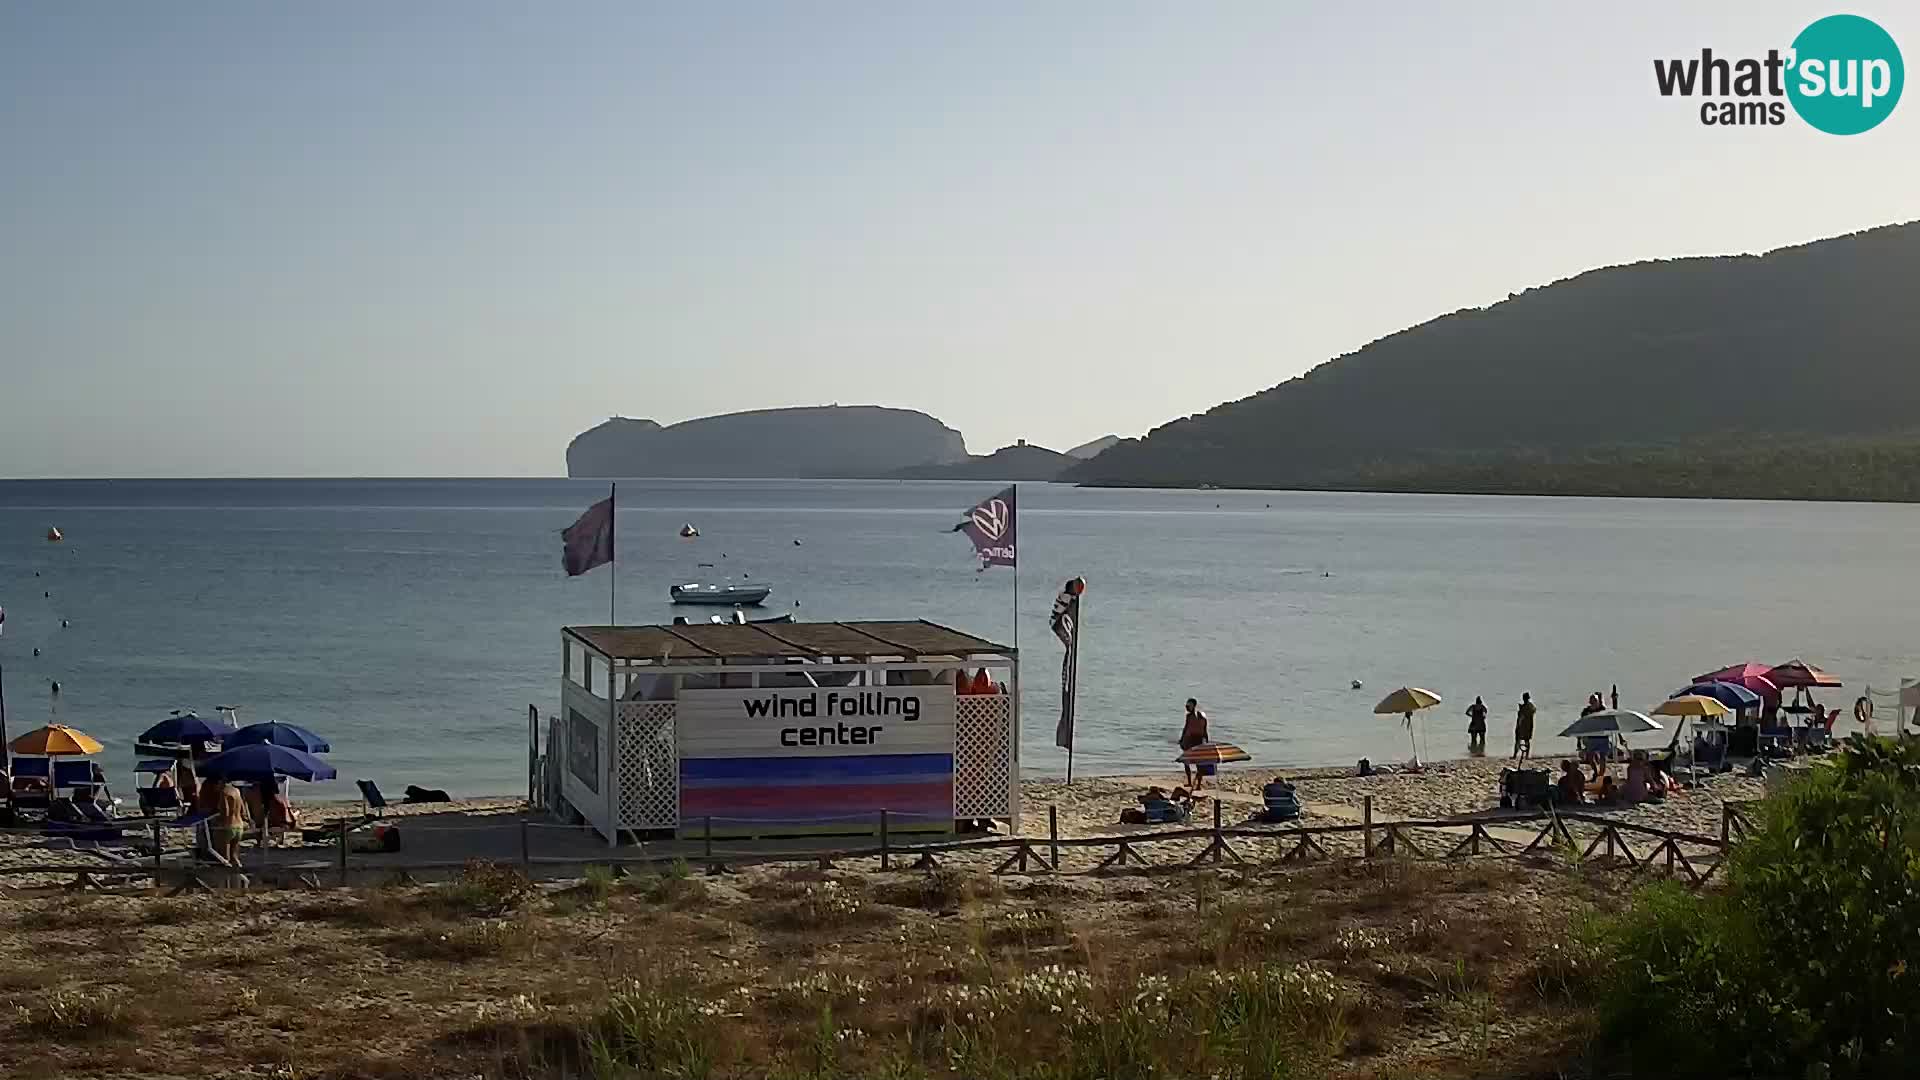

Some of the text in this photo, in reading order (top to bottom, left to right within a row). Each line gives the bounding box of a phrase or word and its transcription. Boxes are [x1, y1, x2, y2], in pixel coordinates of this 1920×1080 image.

[743, 691, 921, 721] wind foiling
[780, 722, 883, 747] center
